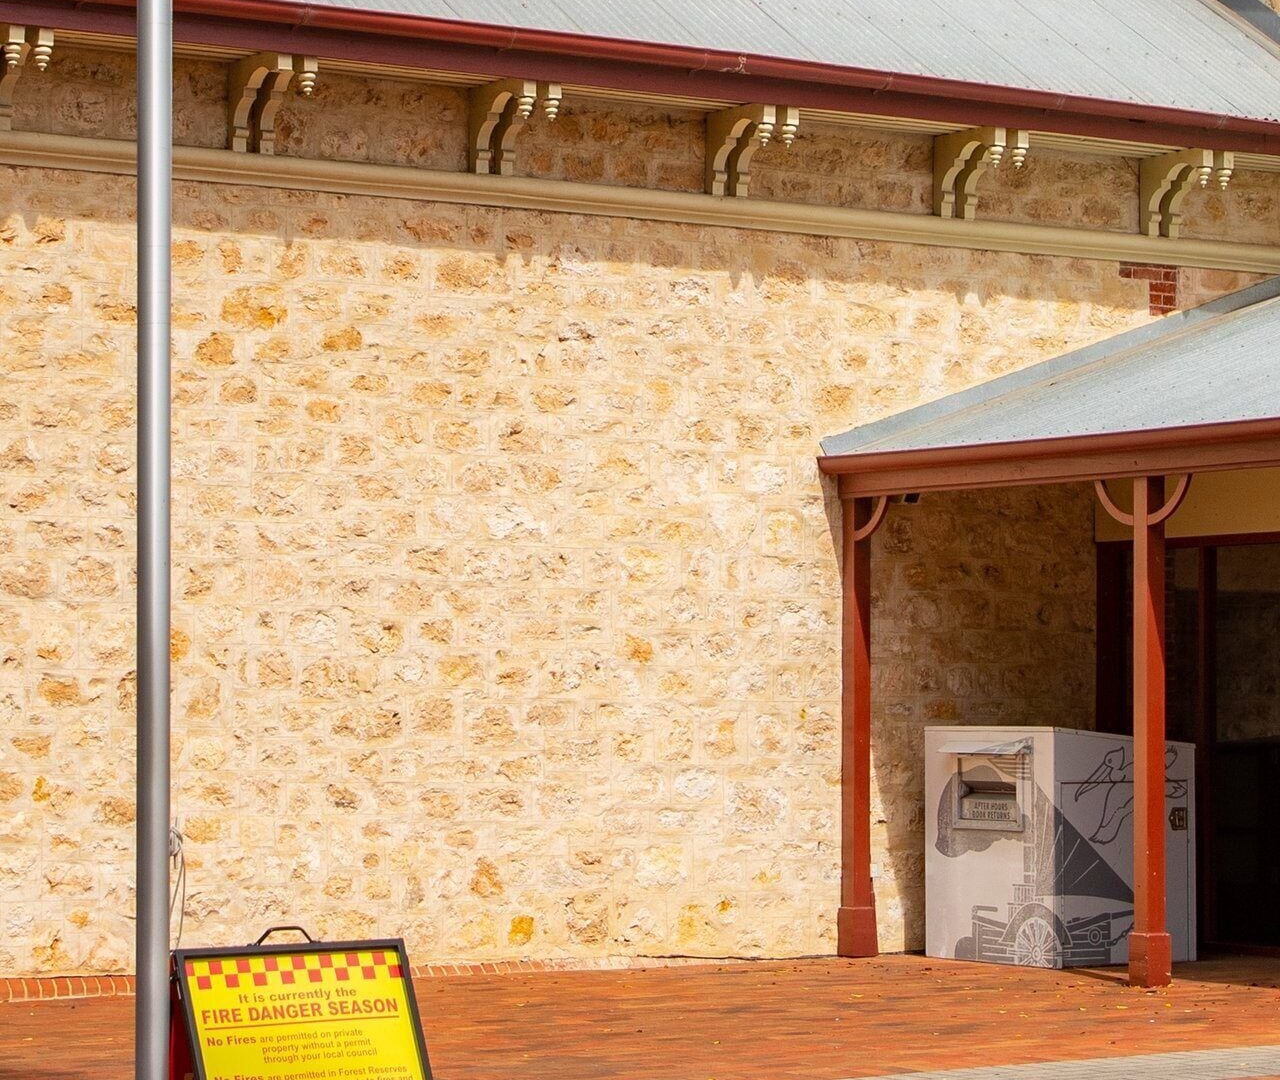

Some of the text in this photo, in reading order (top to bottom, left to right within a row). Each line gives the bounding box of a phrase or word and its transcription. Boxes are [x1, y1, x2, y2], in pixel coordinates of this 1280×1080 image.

[974, 801, 1008, 811] AFTER HOURS
[972, 810, 1010, 820] BOOK RETURNS
[238, 987, 357, 1004] It is currently the
[201, 998, 399, 1025] FIRE DANGER SEASON
[206, 1028, 363, 1047] No Fires are permitted on private
[262, 1043, 299, 1055] property
[301, 1040, 334, 1051] without
[344, 1038, 371, 1049] permit
[263, 1048, 378, 1064] through your local council
[328, 1069, 337, 1078] in
[338, 1066, 367, 1077] Forest
[368, 1065, 408, 1075] Reserves
